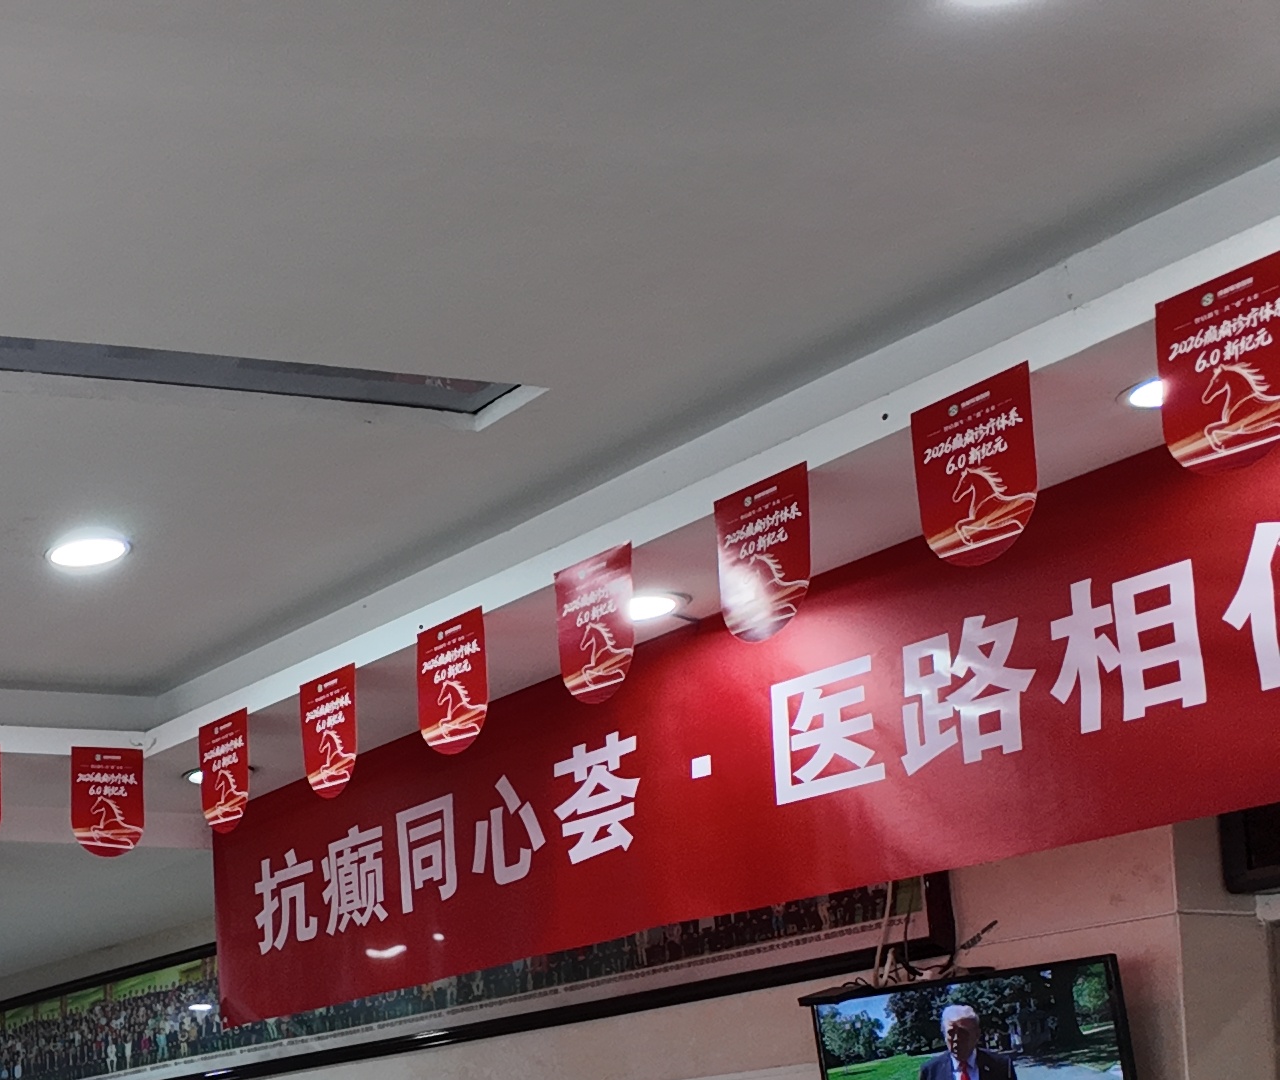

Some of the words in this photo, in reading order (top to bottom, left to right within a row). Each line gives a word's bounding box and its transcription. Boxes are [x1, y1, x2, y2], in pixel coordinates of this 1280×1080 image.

[1195, 349, 1220, 372] 6.0
[1223, 328, 1273, 362] 新纪元
[946, 454, 966, 475] 6.0
[968, 436, 1008, 465] 新纪元
